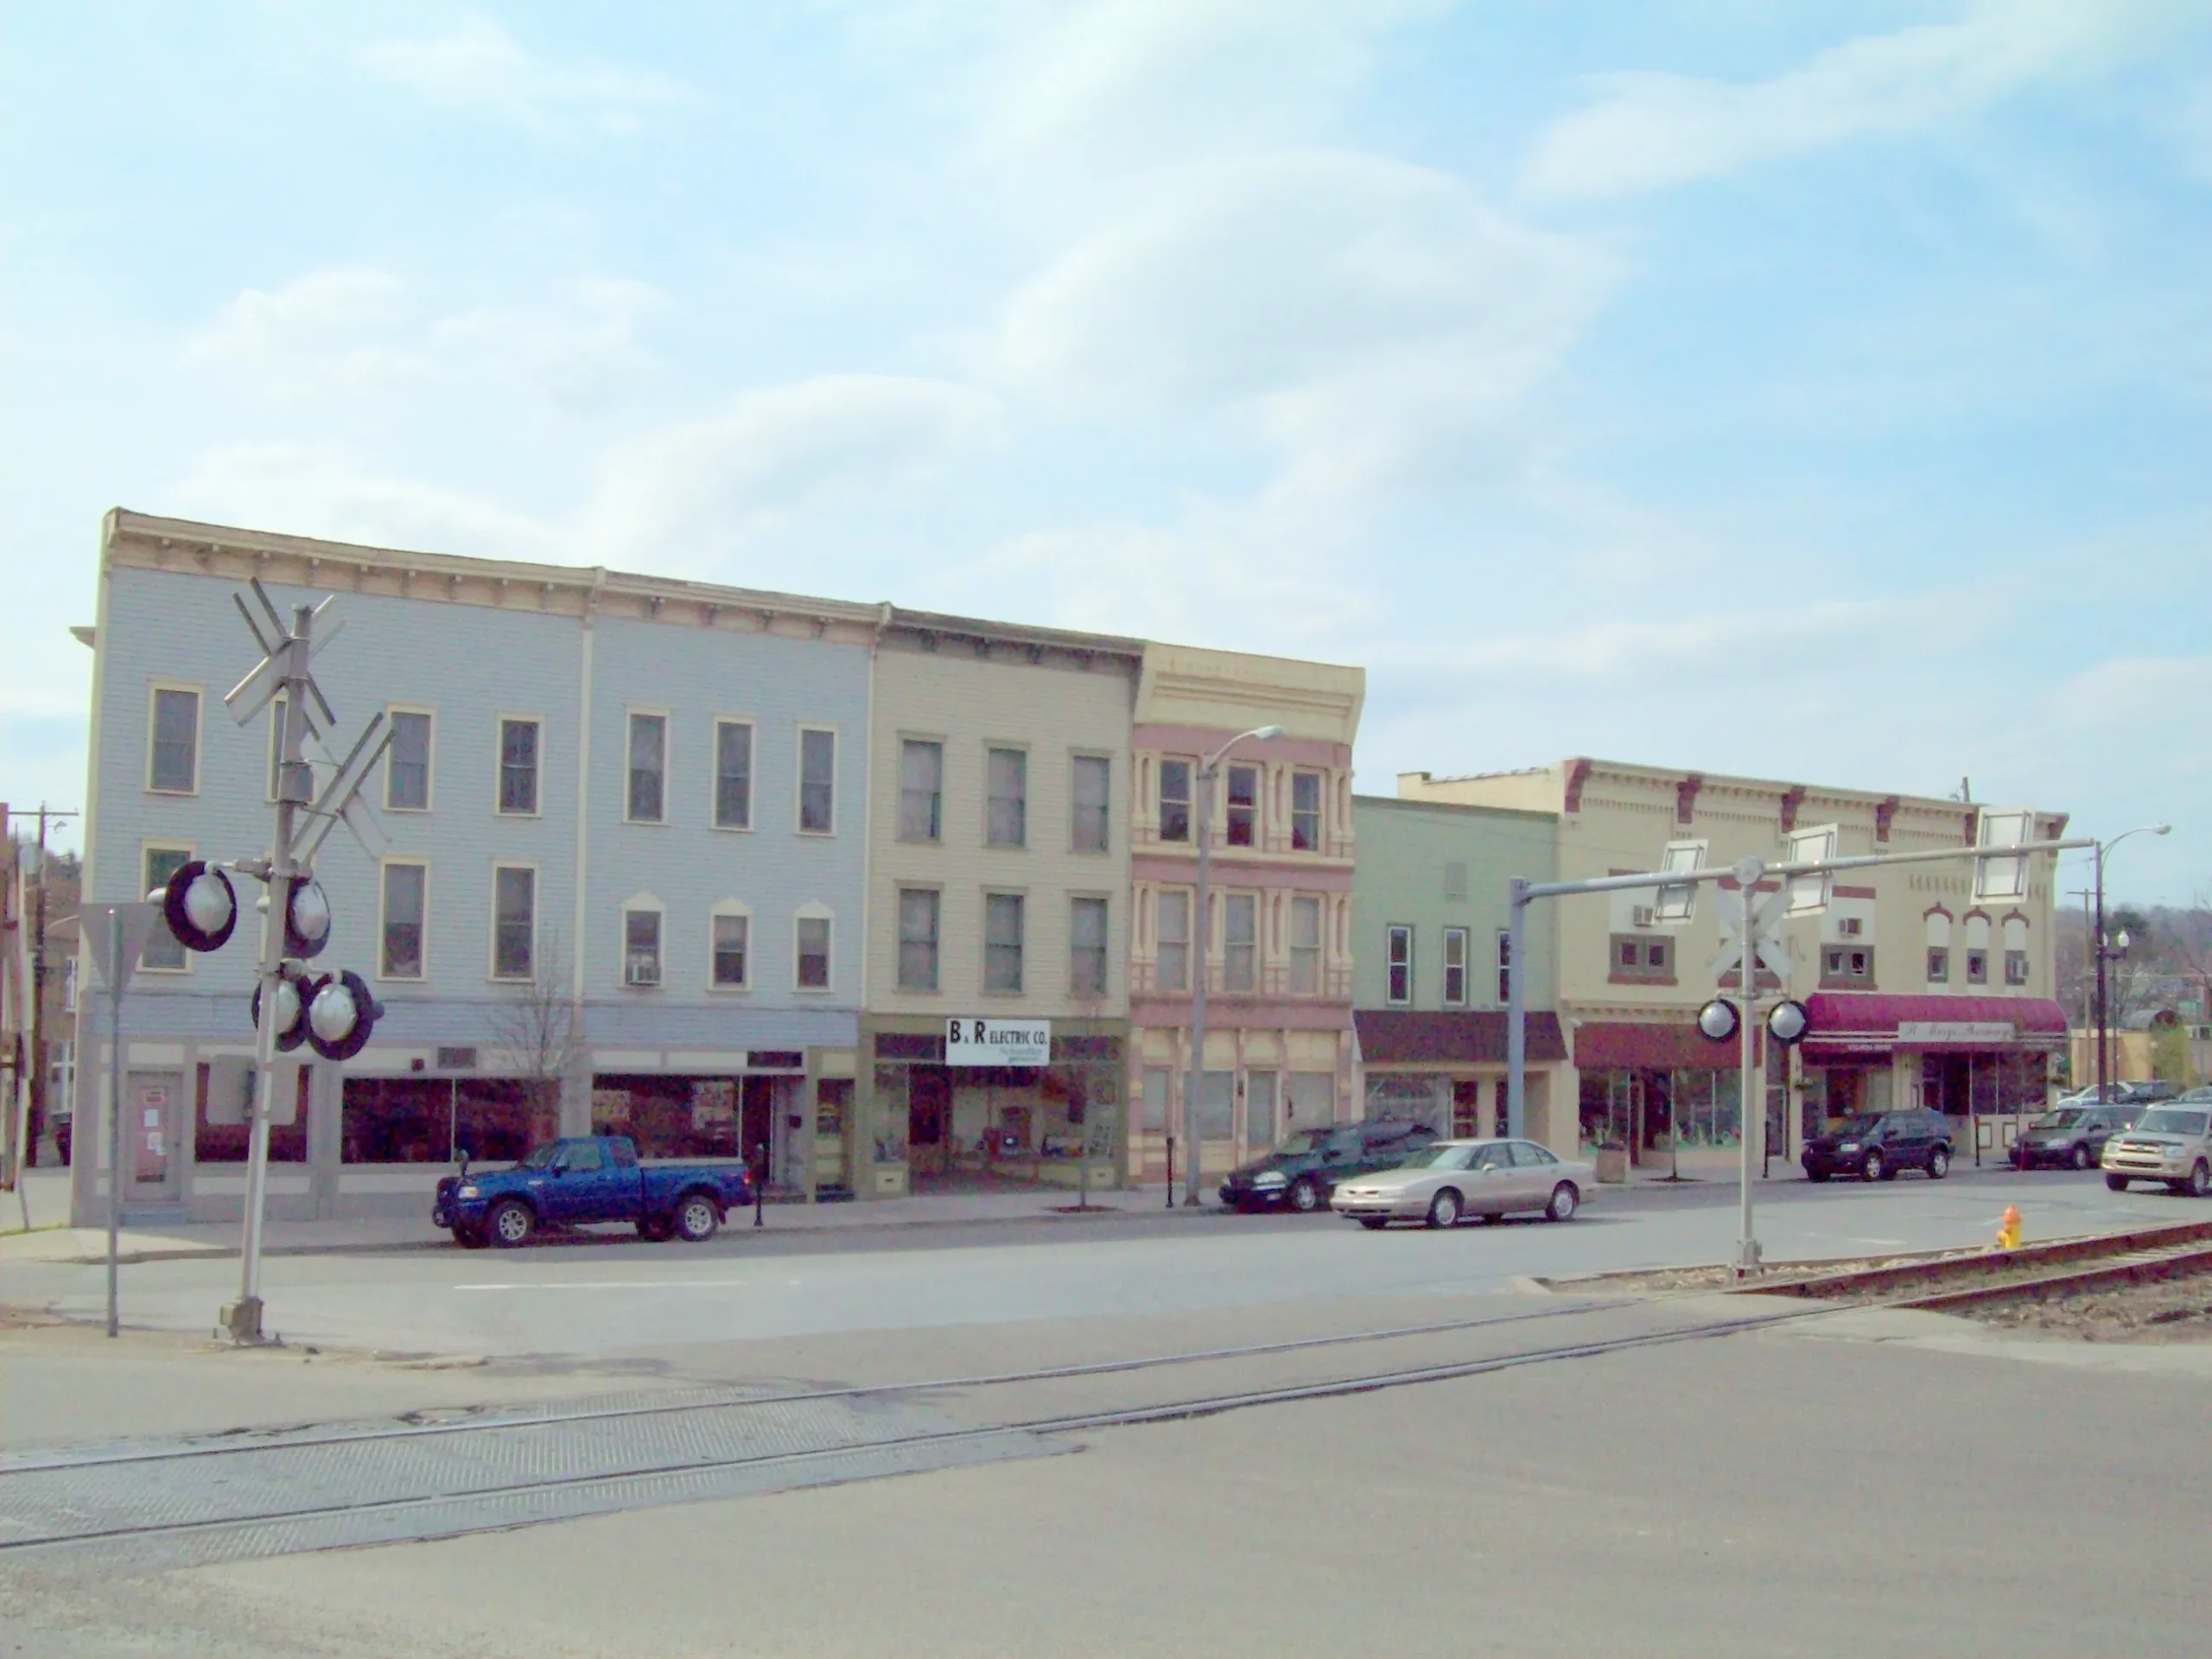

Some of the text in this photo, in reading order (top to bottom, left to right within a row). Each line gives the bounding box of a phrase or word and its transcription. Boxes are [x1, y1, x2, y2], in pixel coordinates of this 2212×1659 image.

[950, 1020, 961, 1044] B
[974, 1021, 985, 1044] R
[989, 1031, 1030, 1045] ELECTRIC
[1033, 1031, 1047, 1045] CO.
